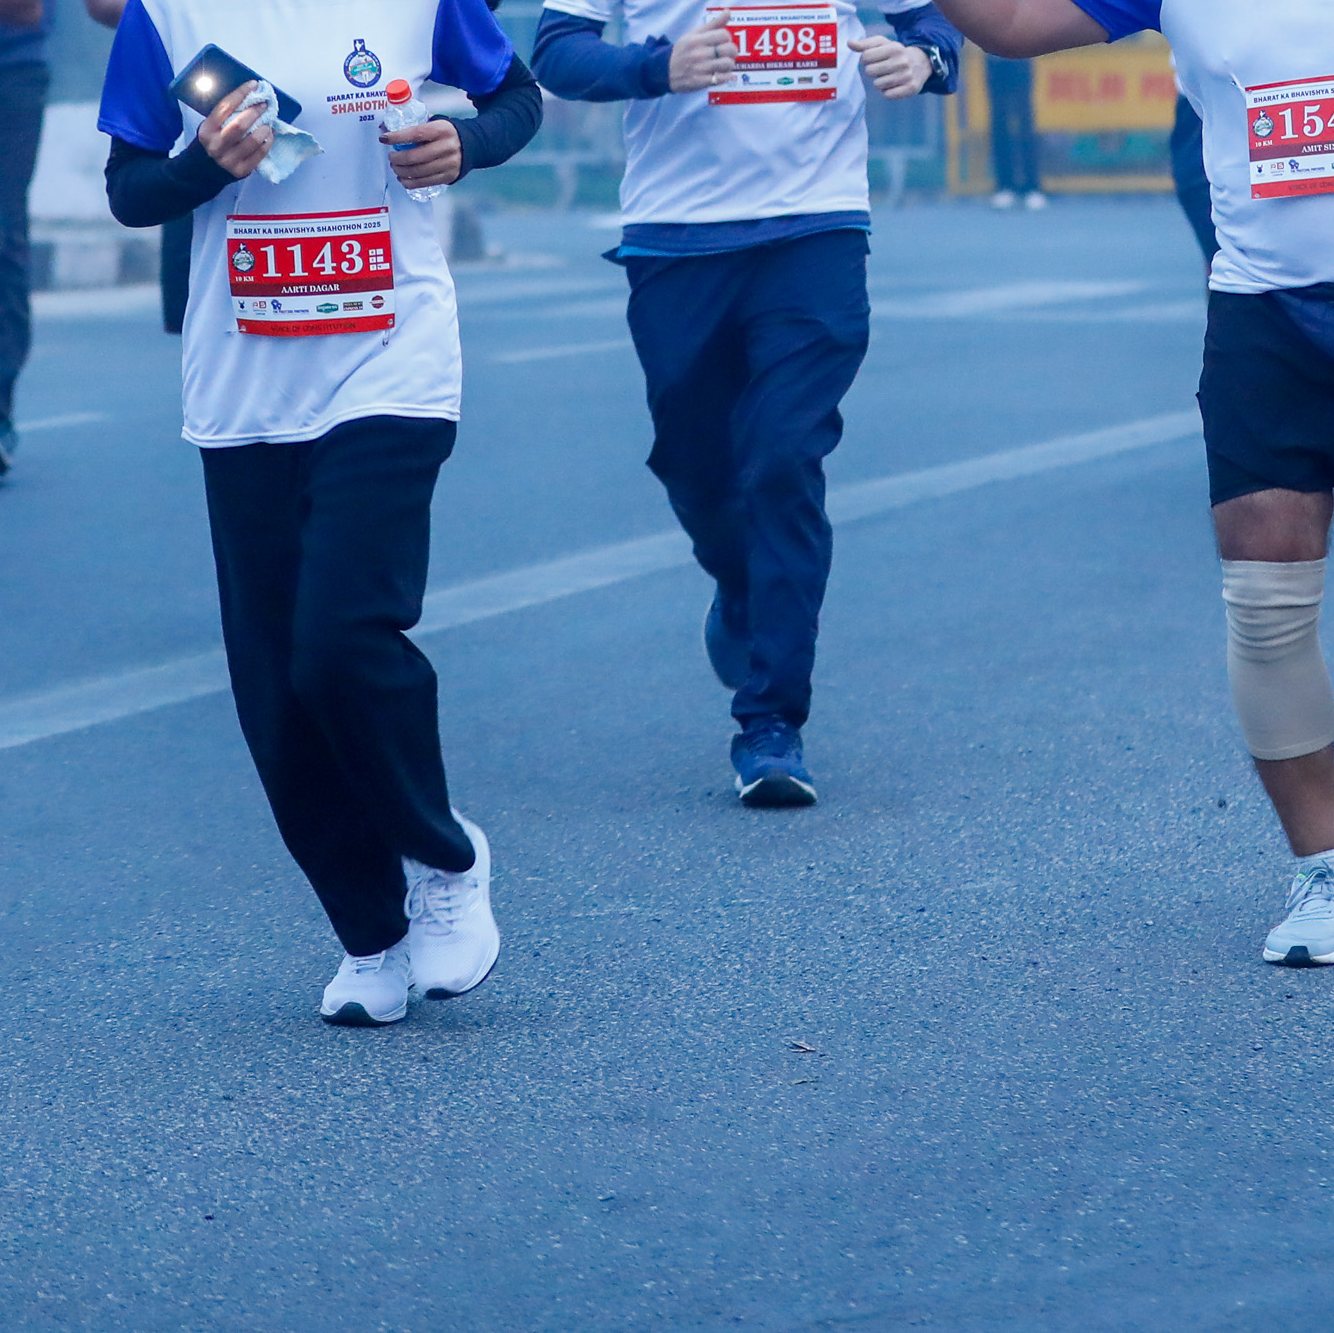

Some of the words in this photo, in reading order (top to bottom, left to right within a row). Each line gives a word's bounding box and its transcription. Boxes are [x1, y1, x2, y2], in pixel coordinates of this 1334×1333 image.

[734, 27, 817, 56] 1498
[327, 93, 354, 102] BHARAT
[1253, 94, 1279, 104] BHARAT
[1280, 92, 1290, 100] KA
[1291, 88, 1330, 98] BHAVISHYA
[331, 100, 387, 114] SHAHOTH
[359, 114, 375, 122] 2025
[1301, 144, 1323, 153] AMIT
[233, 227, 261, 235] BHARAT
[274, 226, 316, 234] BHAVISHYA
[317, 223, 362, 232] SHAHOTHON
[363, 221, 381, 229] 2025
[260, 240, 364, 277] 1143
[281, 285, 308, 294] AARTI
[309, 284, 340, 293] DAGAR
